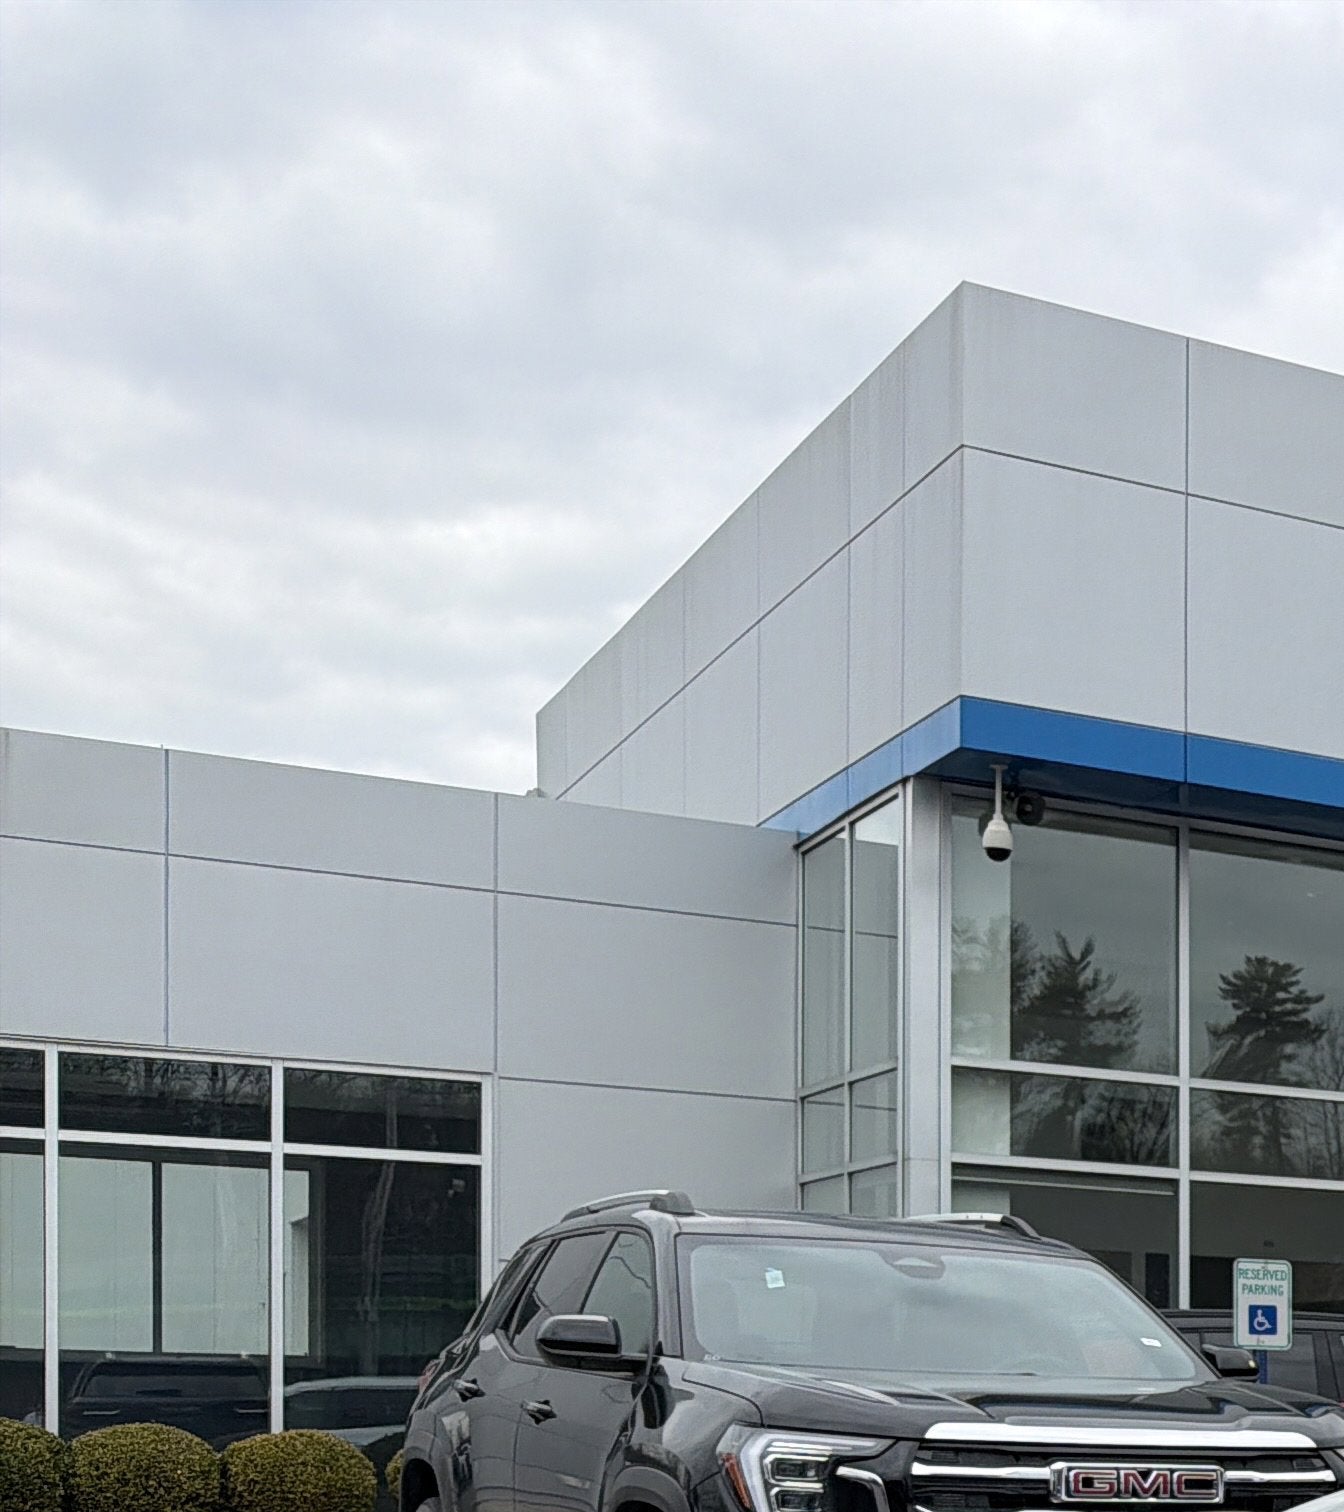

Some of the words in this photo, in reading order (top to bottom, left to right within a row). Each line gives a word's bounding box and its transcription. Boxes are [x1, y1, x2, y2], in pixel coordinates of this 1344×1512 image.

[1238, 1268, 1288, 1281] RESERVED
[1241, 1283, 1285, 1296] PARKING
[1070, 1469, 1218, 1499] GMC
